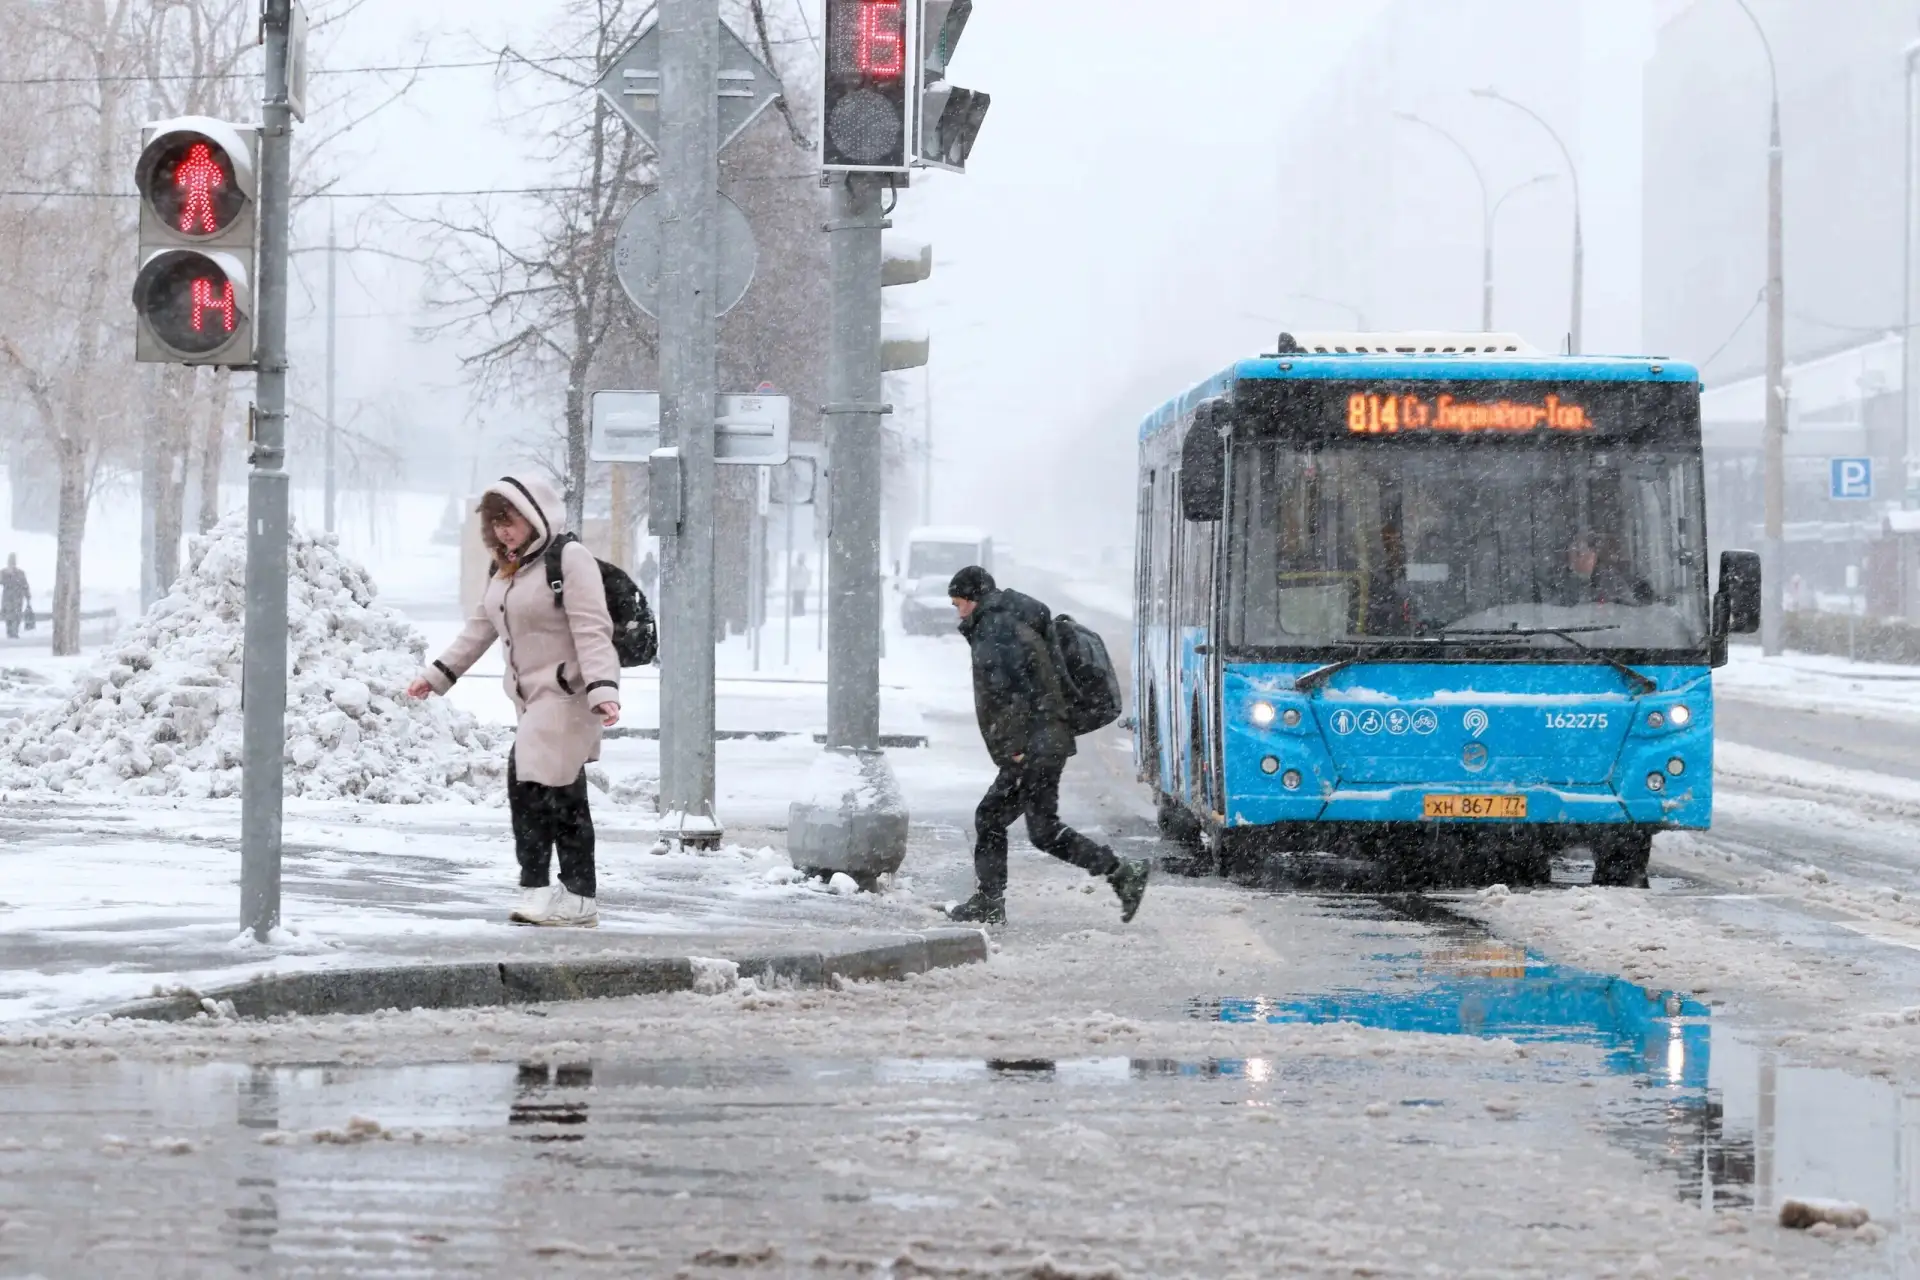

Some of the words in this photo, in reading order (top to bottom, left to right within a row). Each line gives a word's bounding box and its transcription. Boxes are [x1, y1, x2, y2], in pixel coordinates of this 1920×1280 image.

[862, 3, 901, 73] 15
[193, 279, 233, 331] 14
[1348, 392, 1398, 431] 814
[1841, 461, 1866, 496] P
[1545, 712, 1609, 729] 162275
[1462, 797, 1494, 815] 867
[1504, 797, 1520, 810] 77
